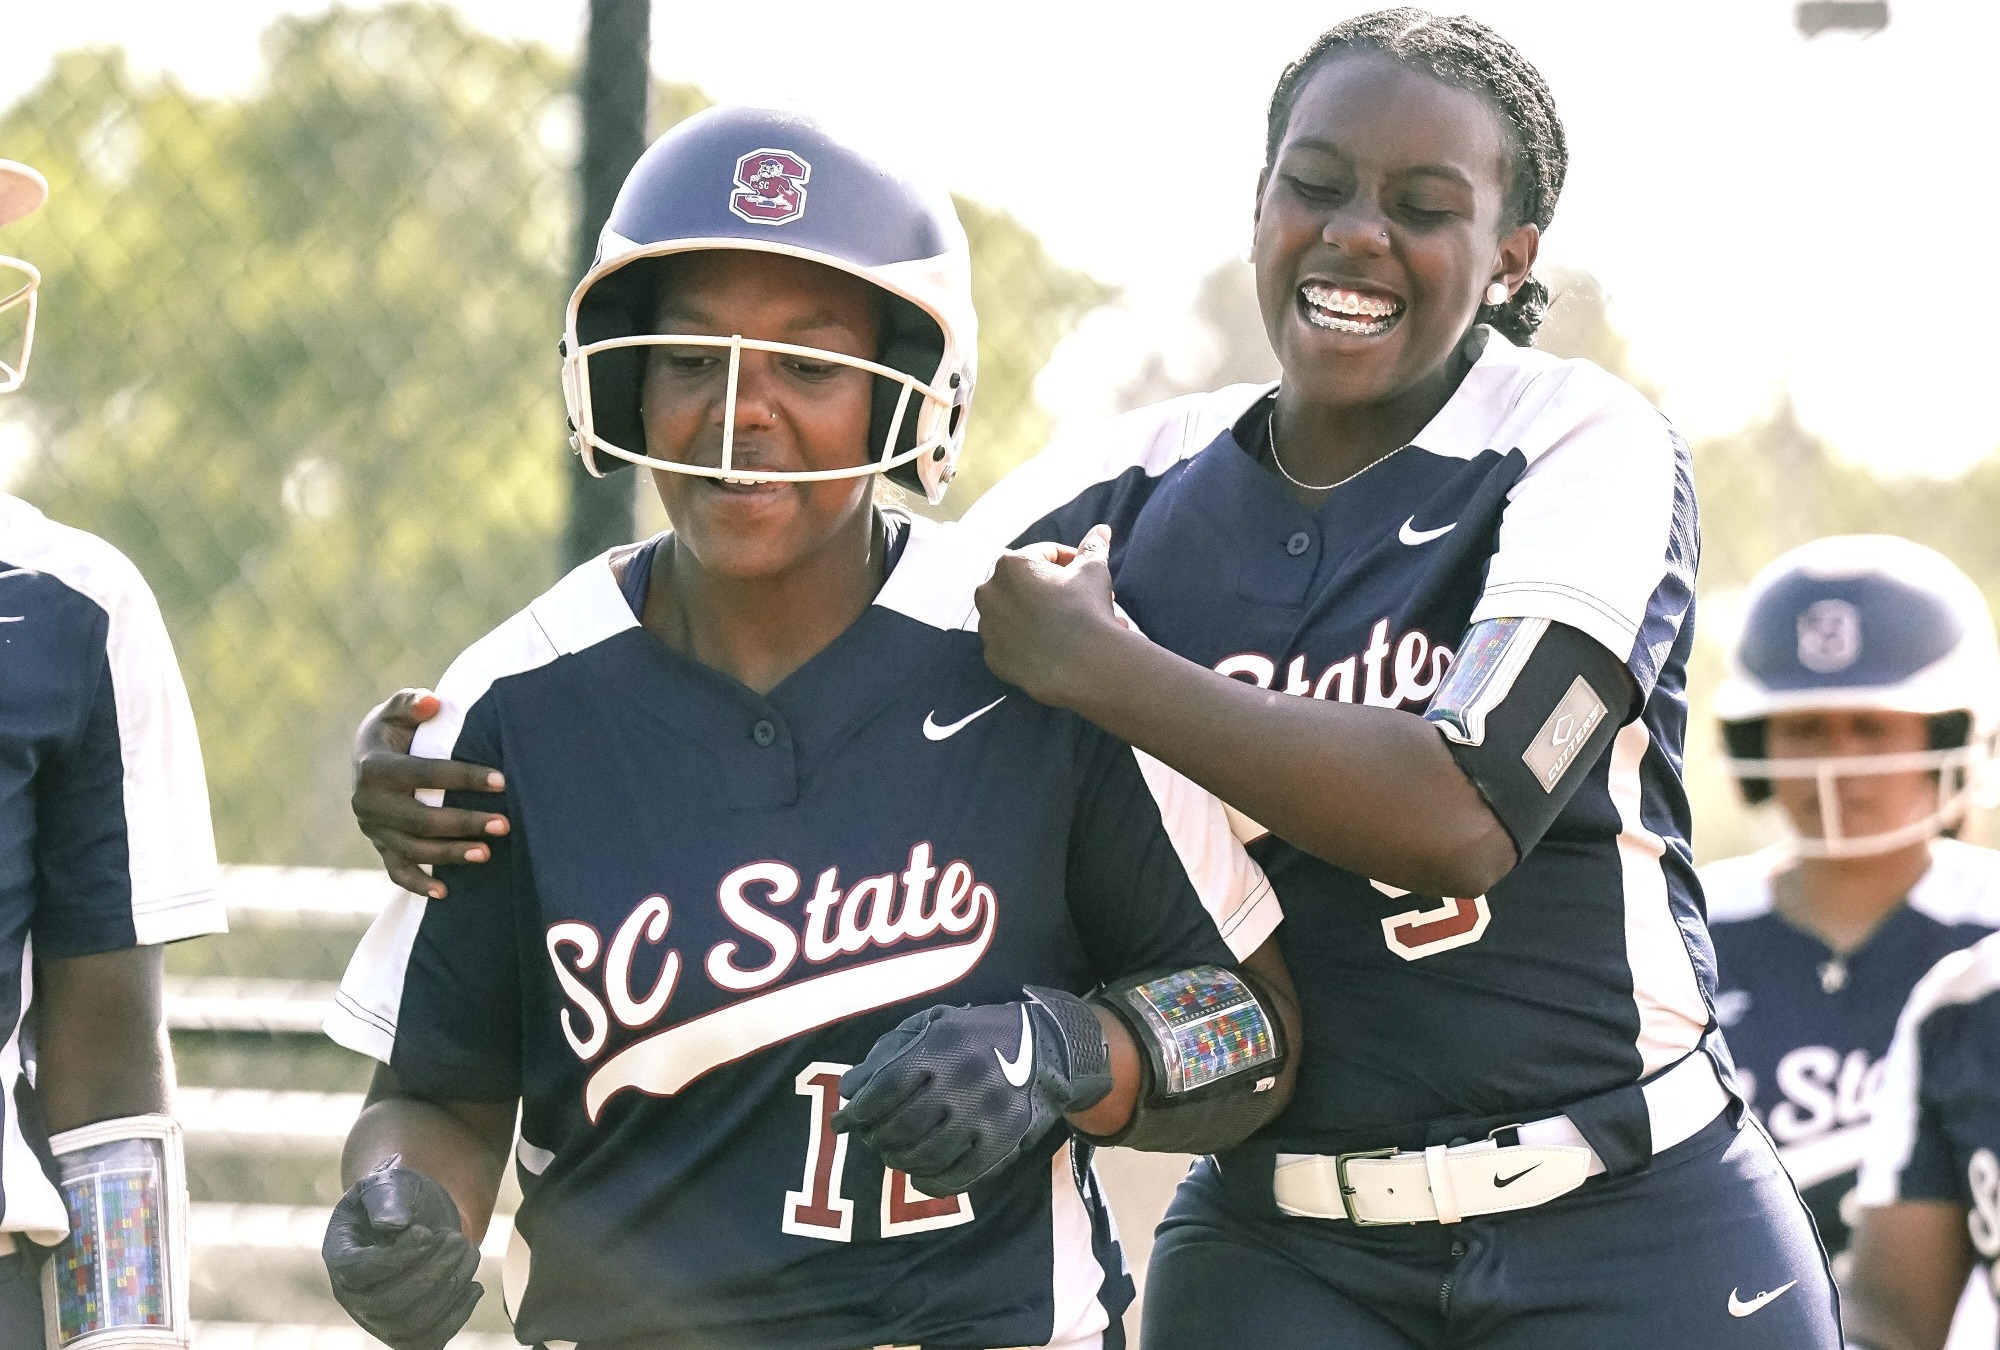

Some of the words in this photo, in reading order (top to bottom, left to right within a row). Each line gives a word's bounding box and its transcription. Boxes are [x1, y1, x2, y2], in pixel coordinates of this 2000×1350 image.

[1547, 702, 1601, 782] CUTTERS
[546, 893, 682, 1063] SC
[704, 839, 998, 993] State
